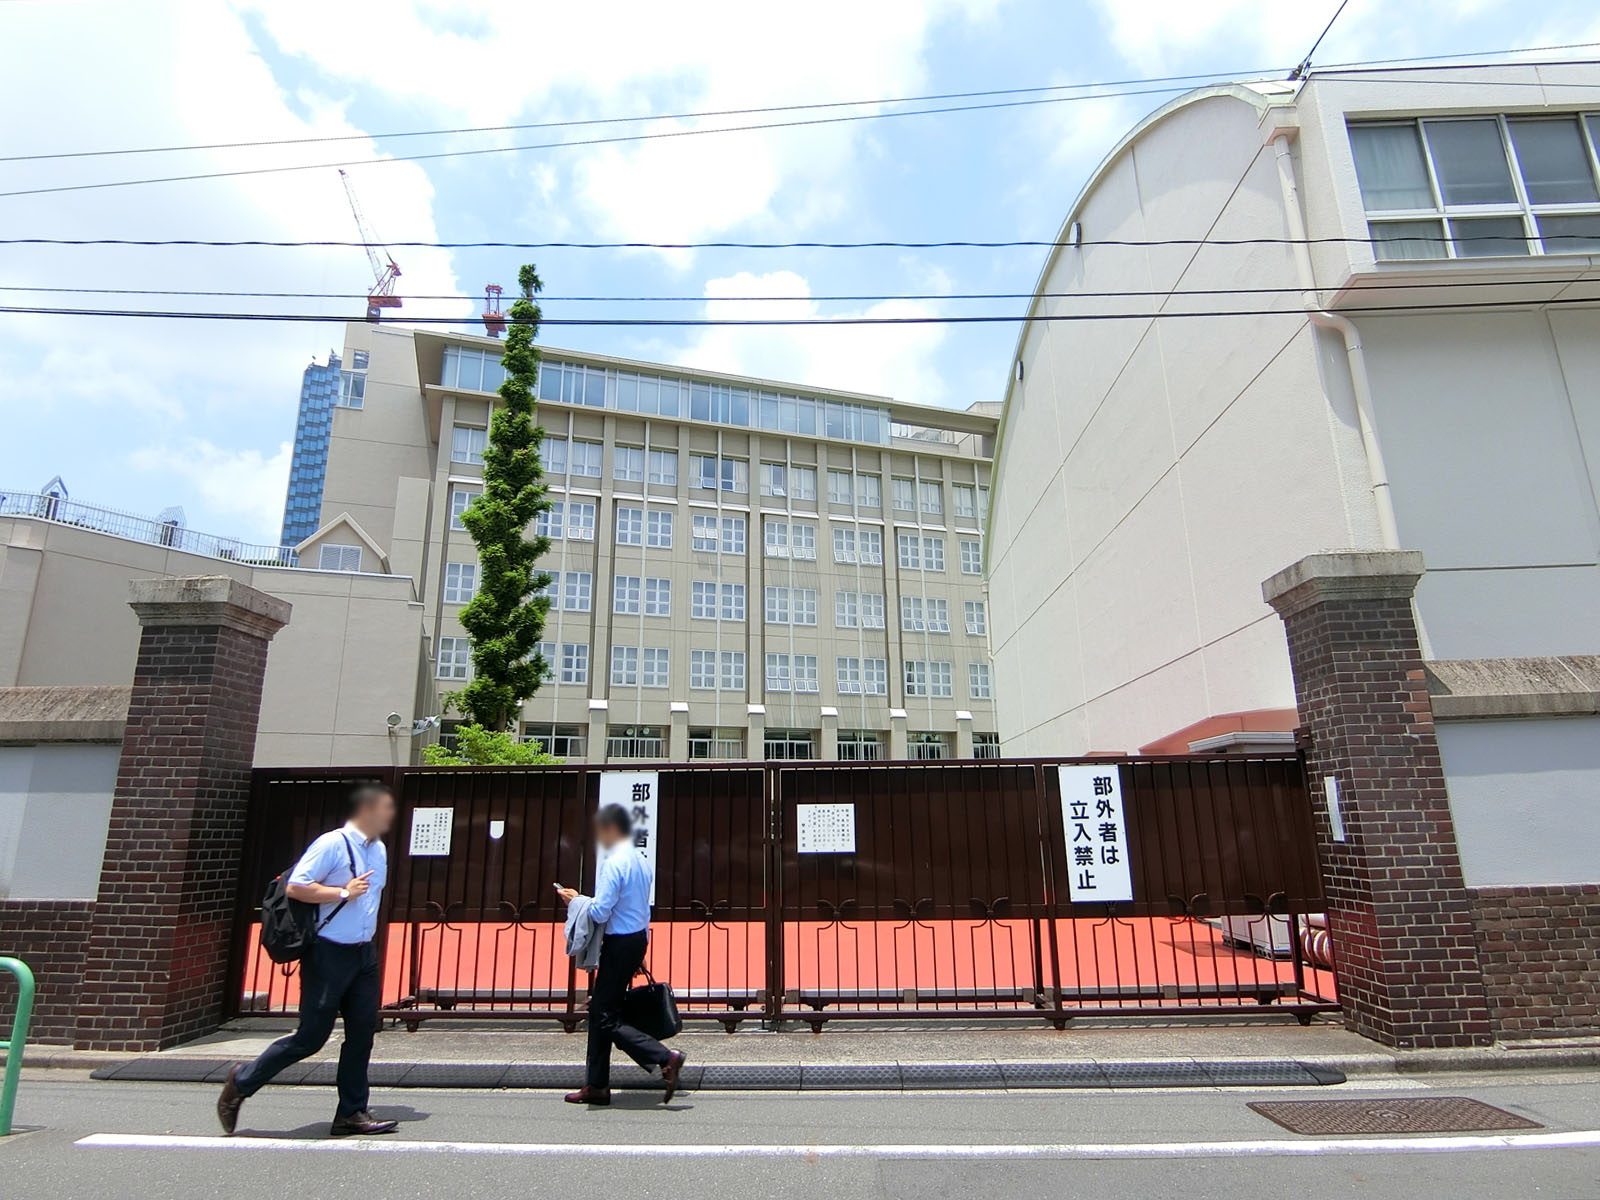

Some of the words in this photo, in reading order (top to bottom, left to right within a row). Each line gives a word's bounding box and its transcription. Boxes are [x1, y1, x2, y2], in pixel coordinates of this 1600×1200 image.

[632, 783, 651, 858] 部外者
[1070, 800, 1097, 890] 立入禁止
[1093, 776, 1120, 865] 部外者は
